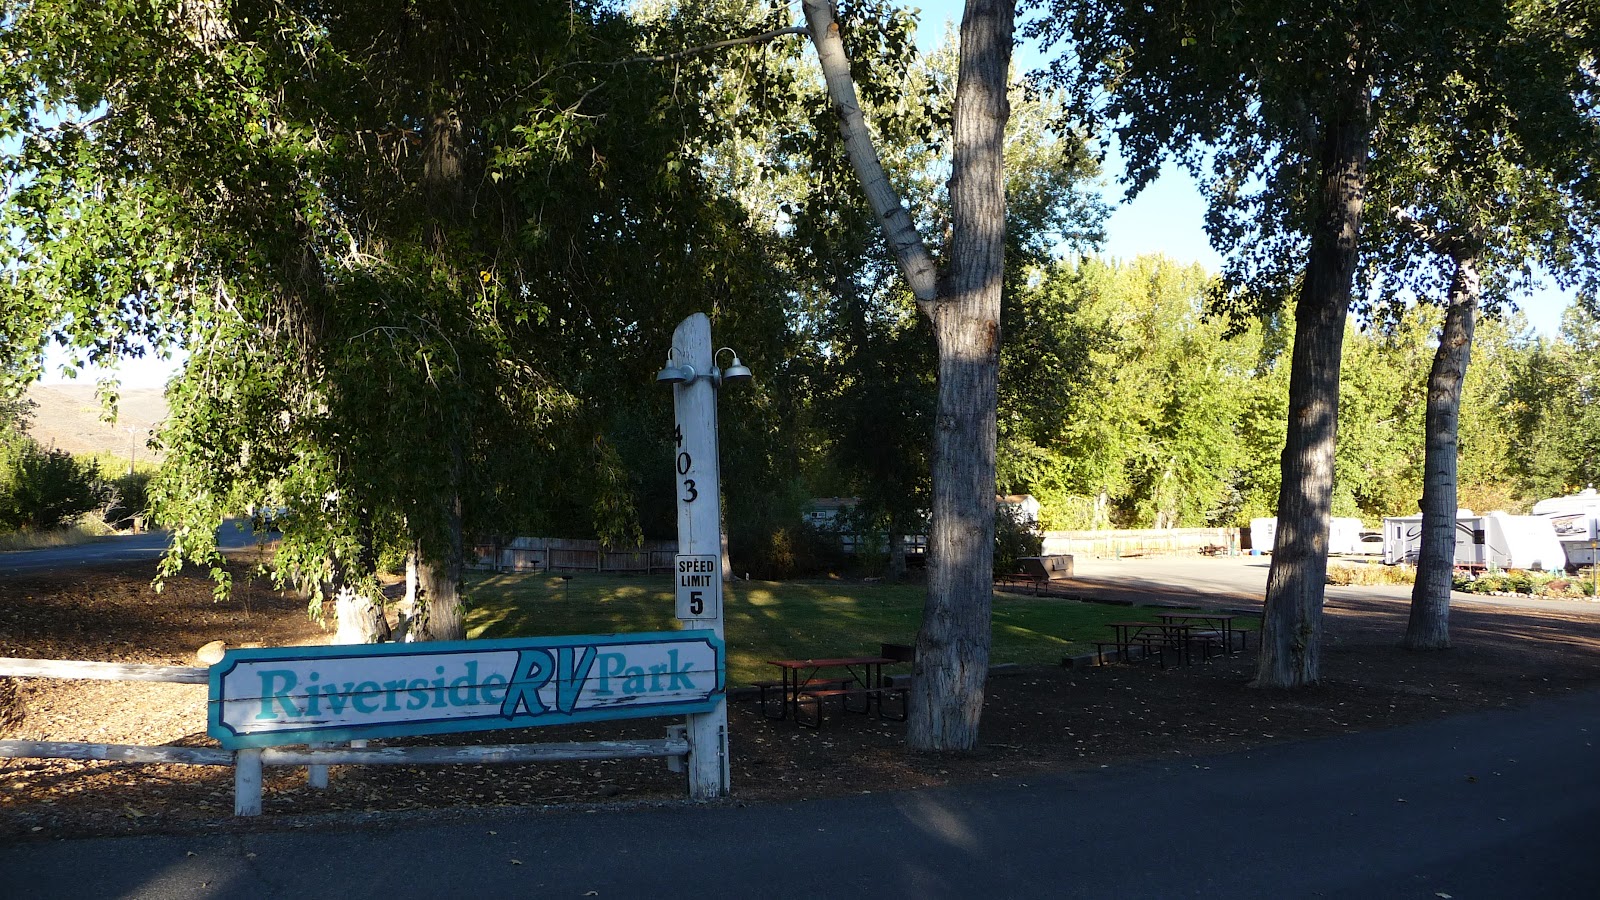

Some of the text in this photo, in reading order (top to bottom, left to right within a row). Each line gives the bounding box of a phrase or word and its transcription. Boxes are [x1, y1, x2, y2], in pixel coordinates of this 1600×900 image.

[679, 560, 714, 573] SPEED
[681, 575, 711, 587] LIMIT
[690, 591, 704, 615] 5
[255, 646, 696, 721] Riverside RV Park
